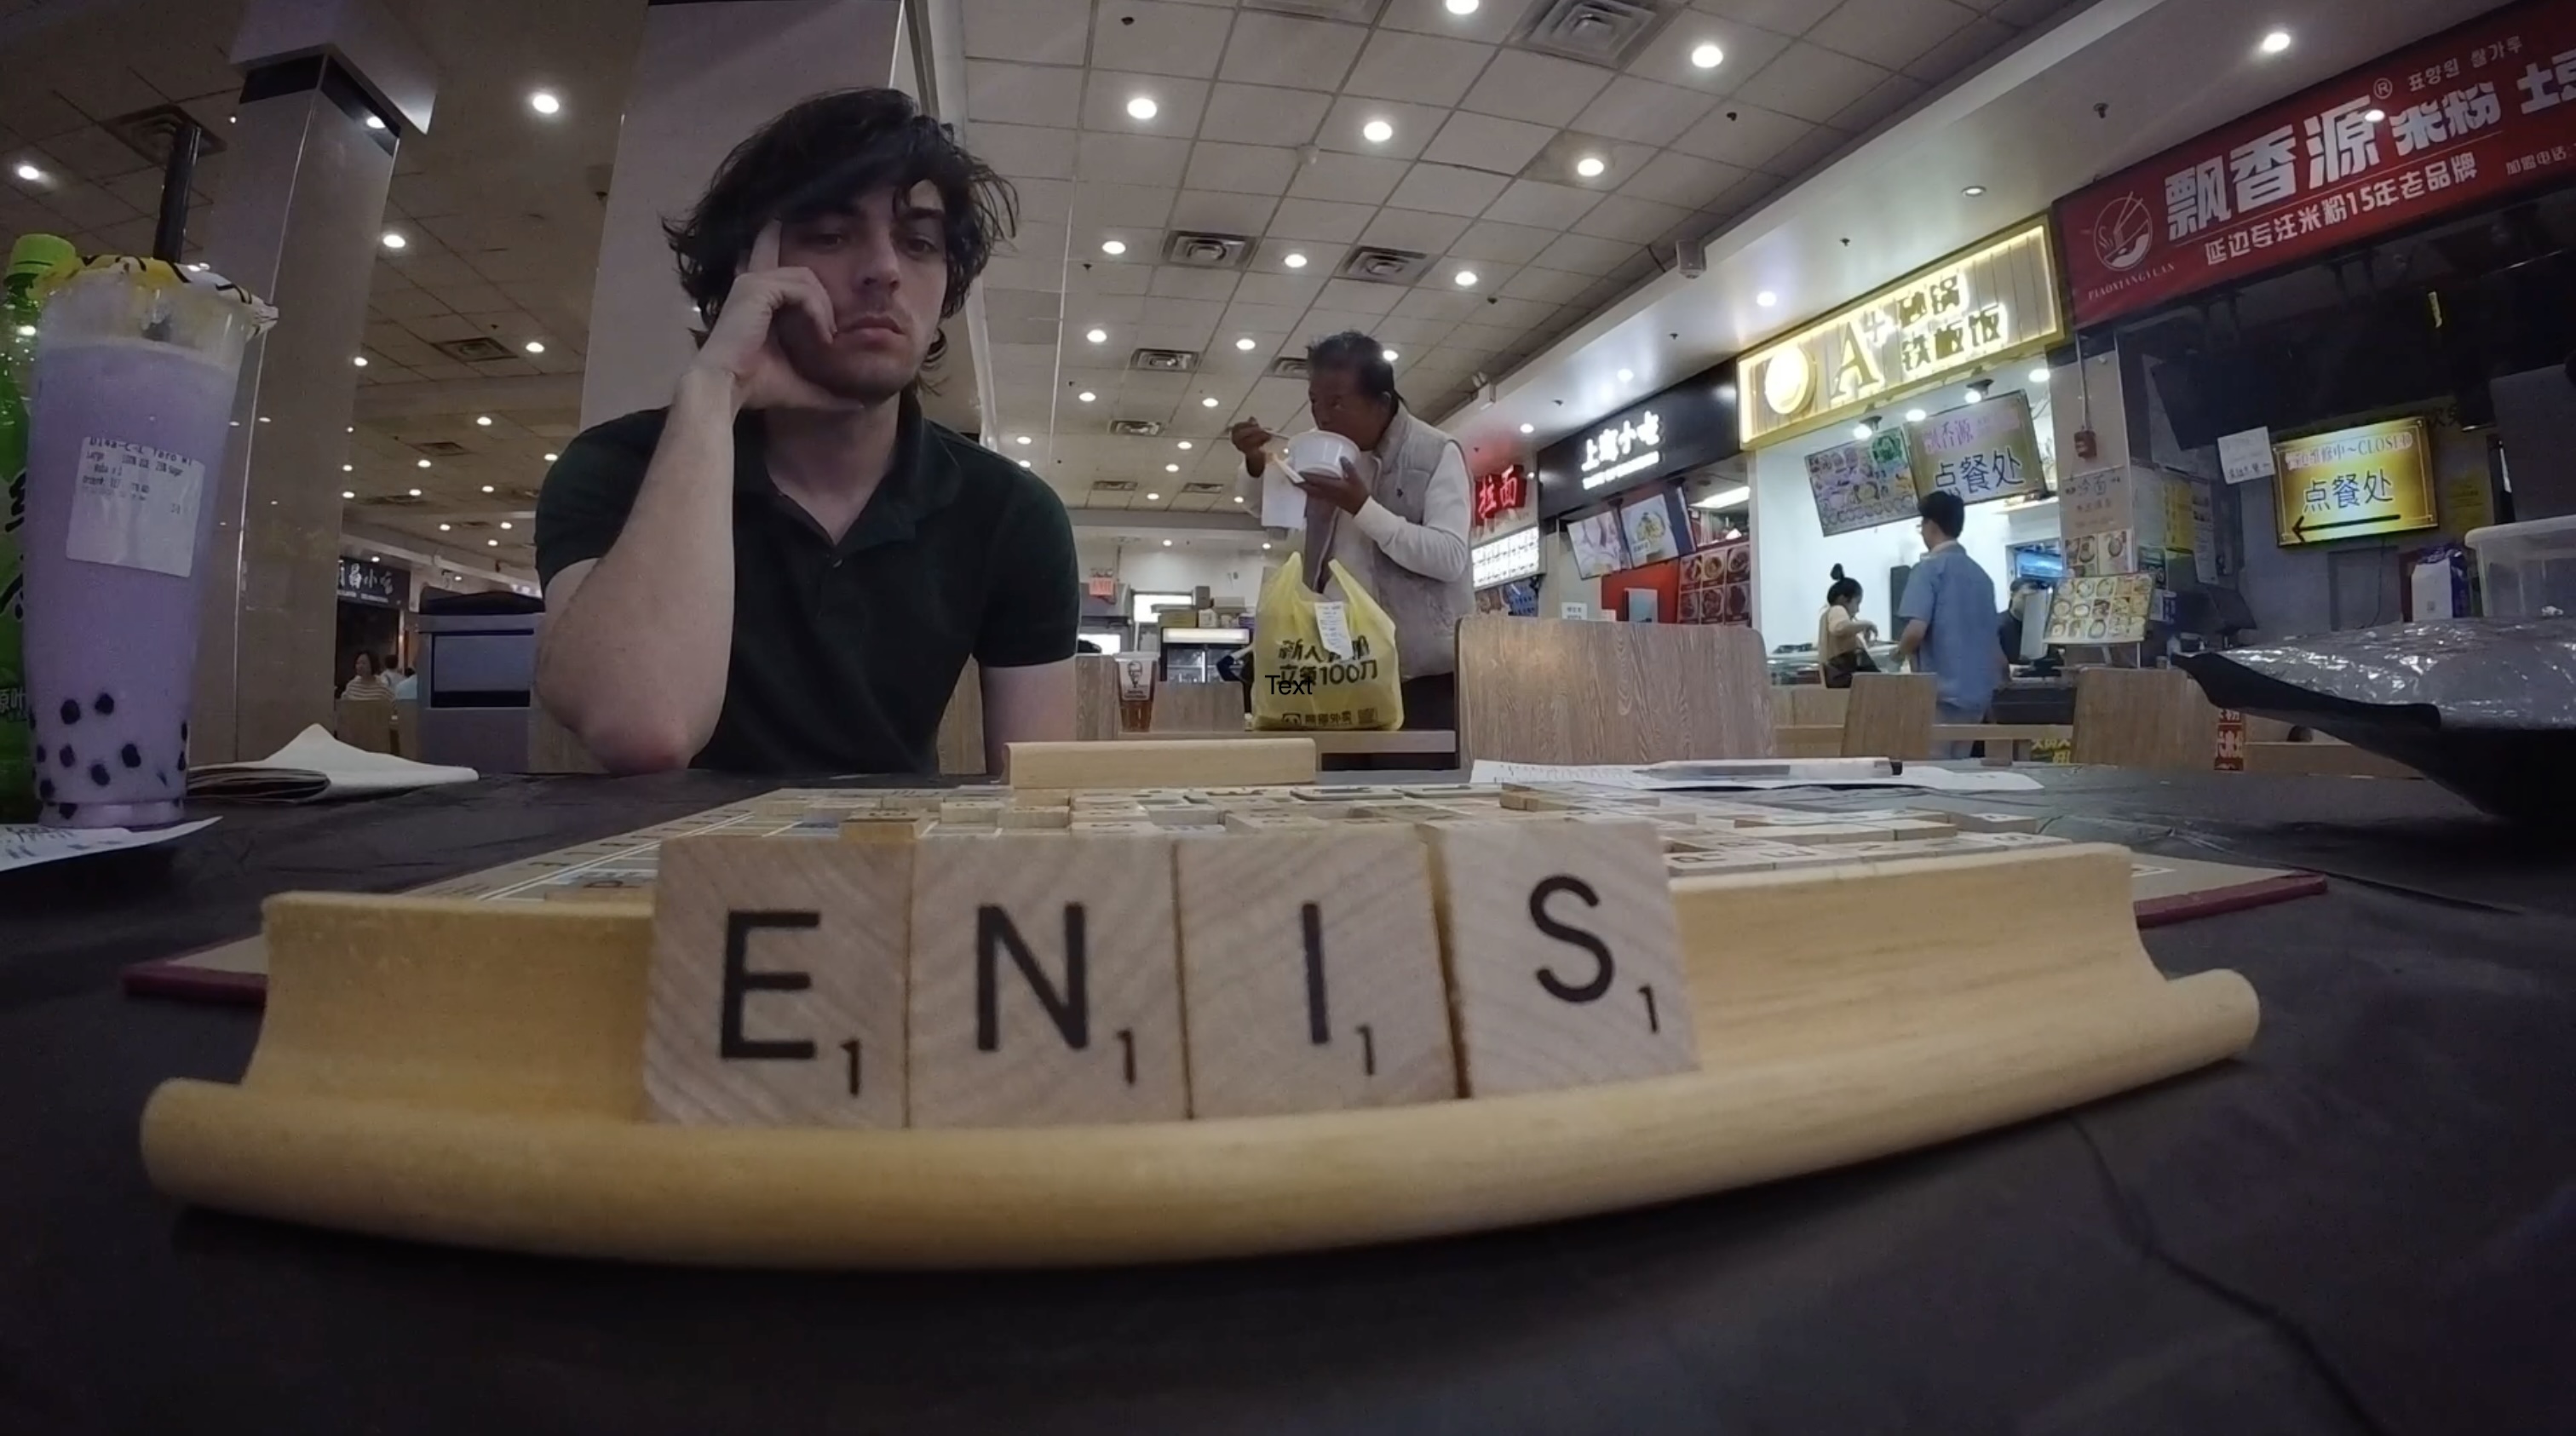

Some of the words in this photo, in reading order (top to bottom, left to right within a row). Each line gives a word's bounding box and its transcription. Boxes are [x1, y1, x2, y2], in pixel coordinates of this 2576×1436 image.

[2165, 95, 2380, 241] 飘香源
[2389, 81, 2501, 157] 米粉
[2303, 468, 2394, 513] 点餐处
[722, 910, 822, 1060] E
[977, 903, 1088, 1051] N
[1301, 903, 1331, 1045] I
[1530, 876, 1614, 1003] S
